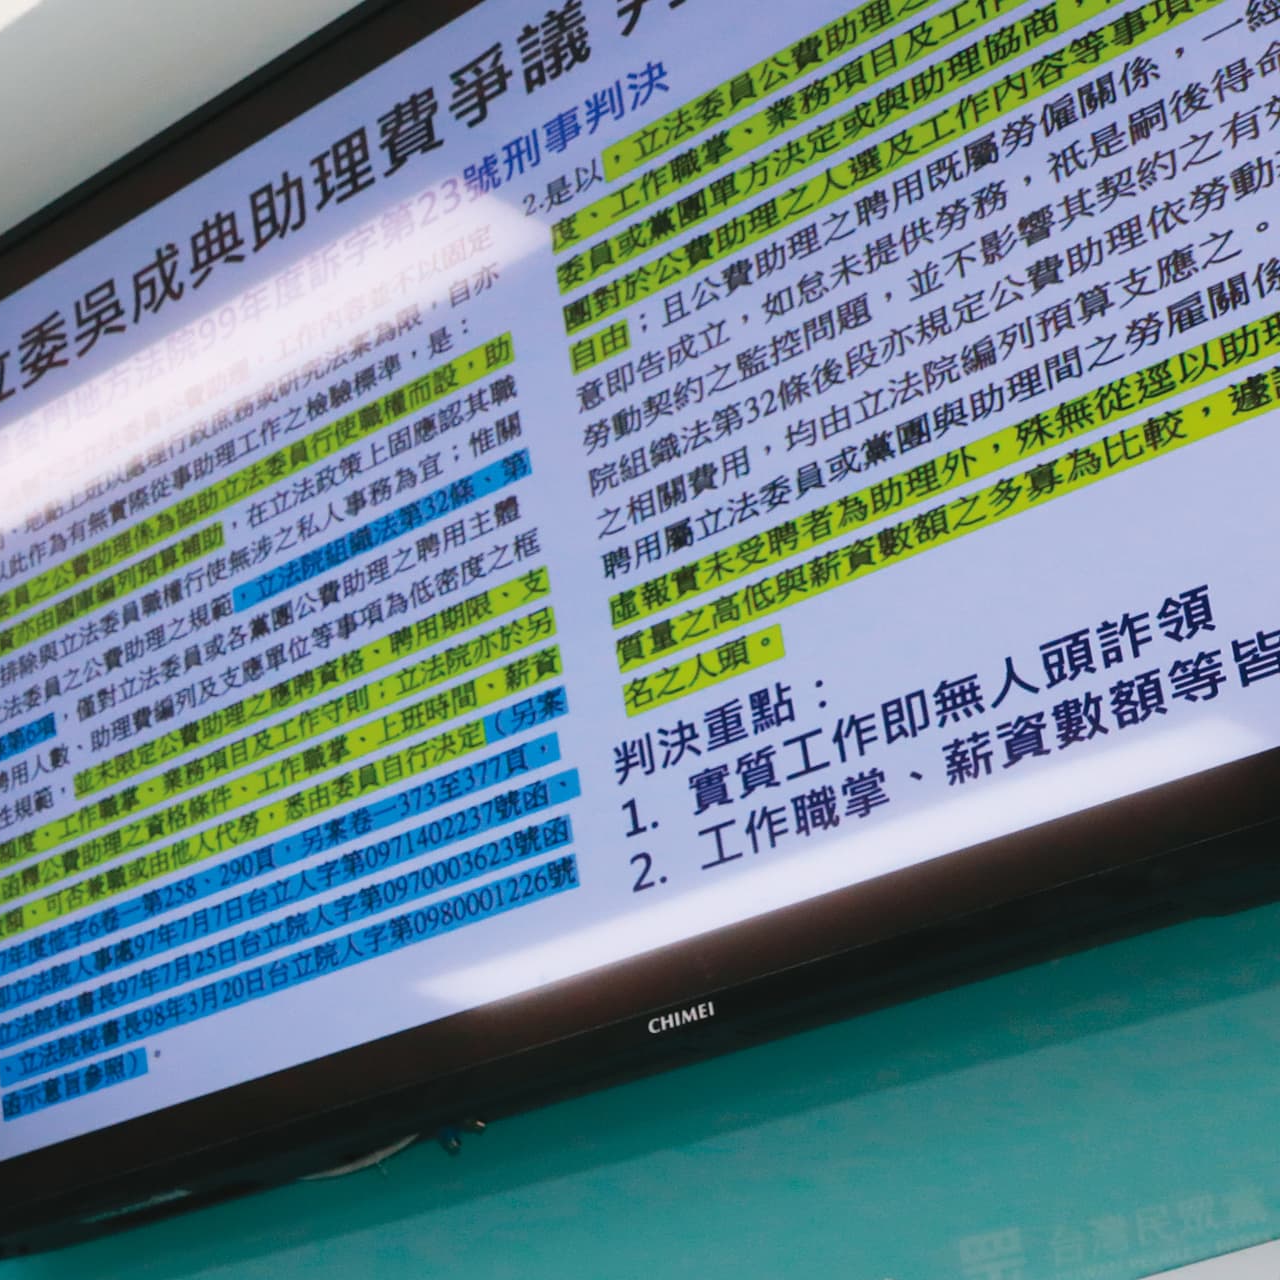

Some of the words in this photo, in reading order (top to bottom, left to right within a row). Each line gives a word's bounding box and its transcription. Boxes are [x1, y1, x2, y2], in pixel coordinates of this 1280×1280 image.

[588, 146, 1280, 499] 院組織法第32條後段亦規定公費助理依勞動
[614, 363, 1280, 670] 質量之高低與薪資數額之多寡為比較，遽
[610, 663, 831, 788] 判決重點：
[619, 790, 660, 840] 1.
[685, 581, 1219, 817] 實質工作即無人頭詐領
[621, 624, 774, 713] 名之人頭。
[626, 844, 669, 895] 2.
[694, 622, 1280, 874] 工作職掌、薪資數額等皆
[647, 1001, 715, 1034] CHIMEI
